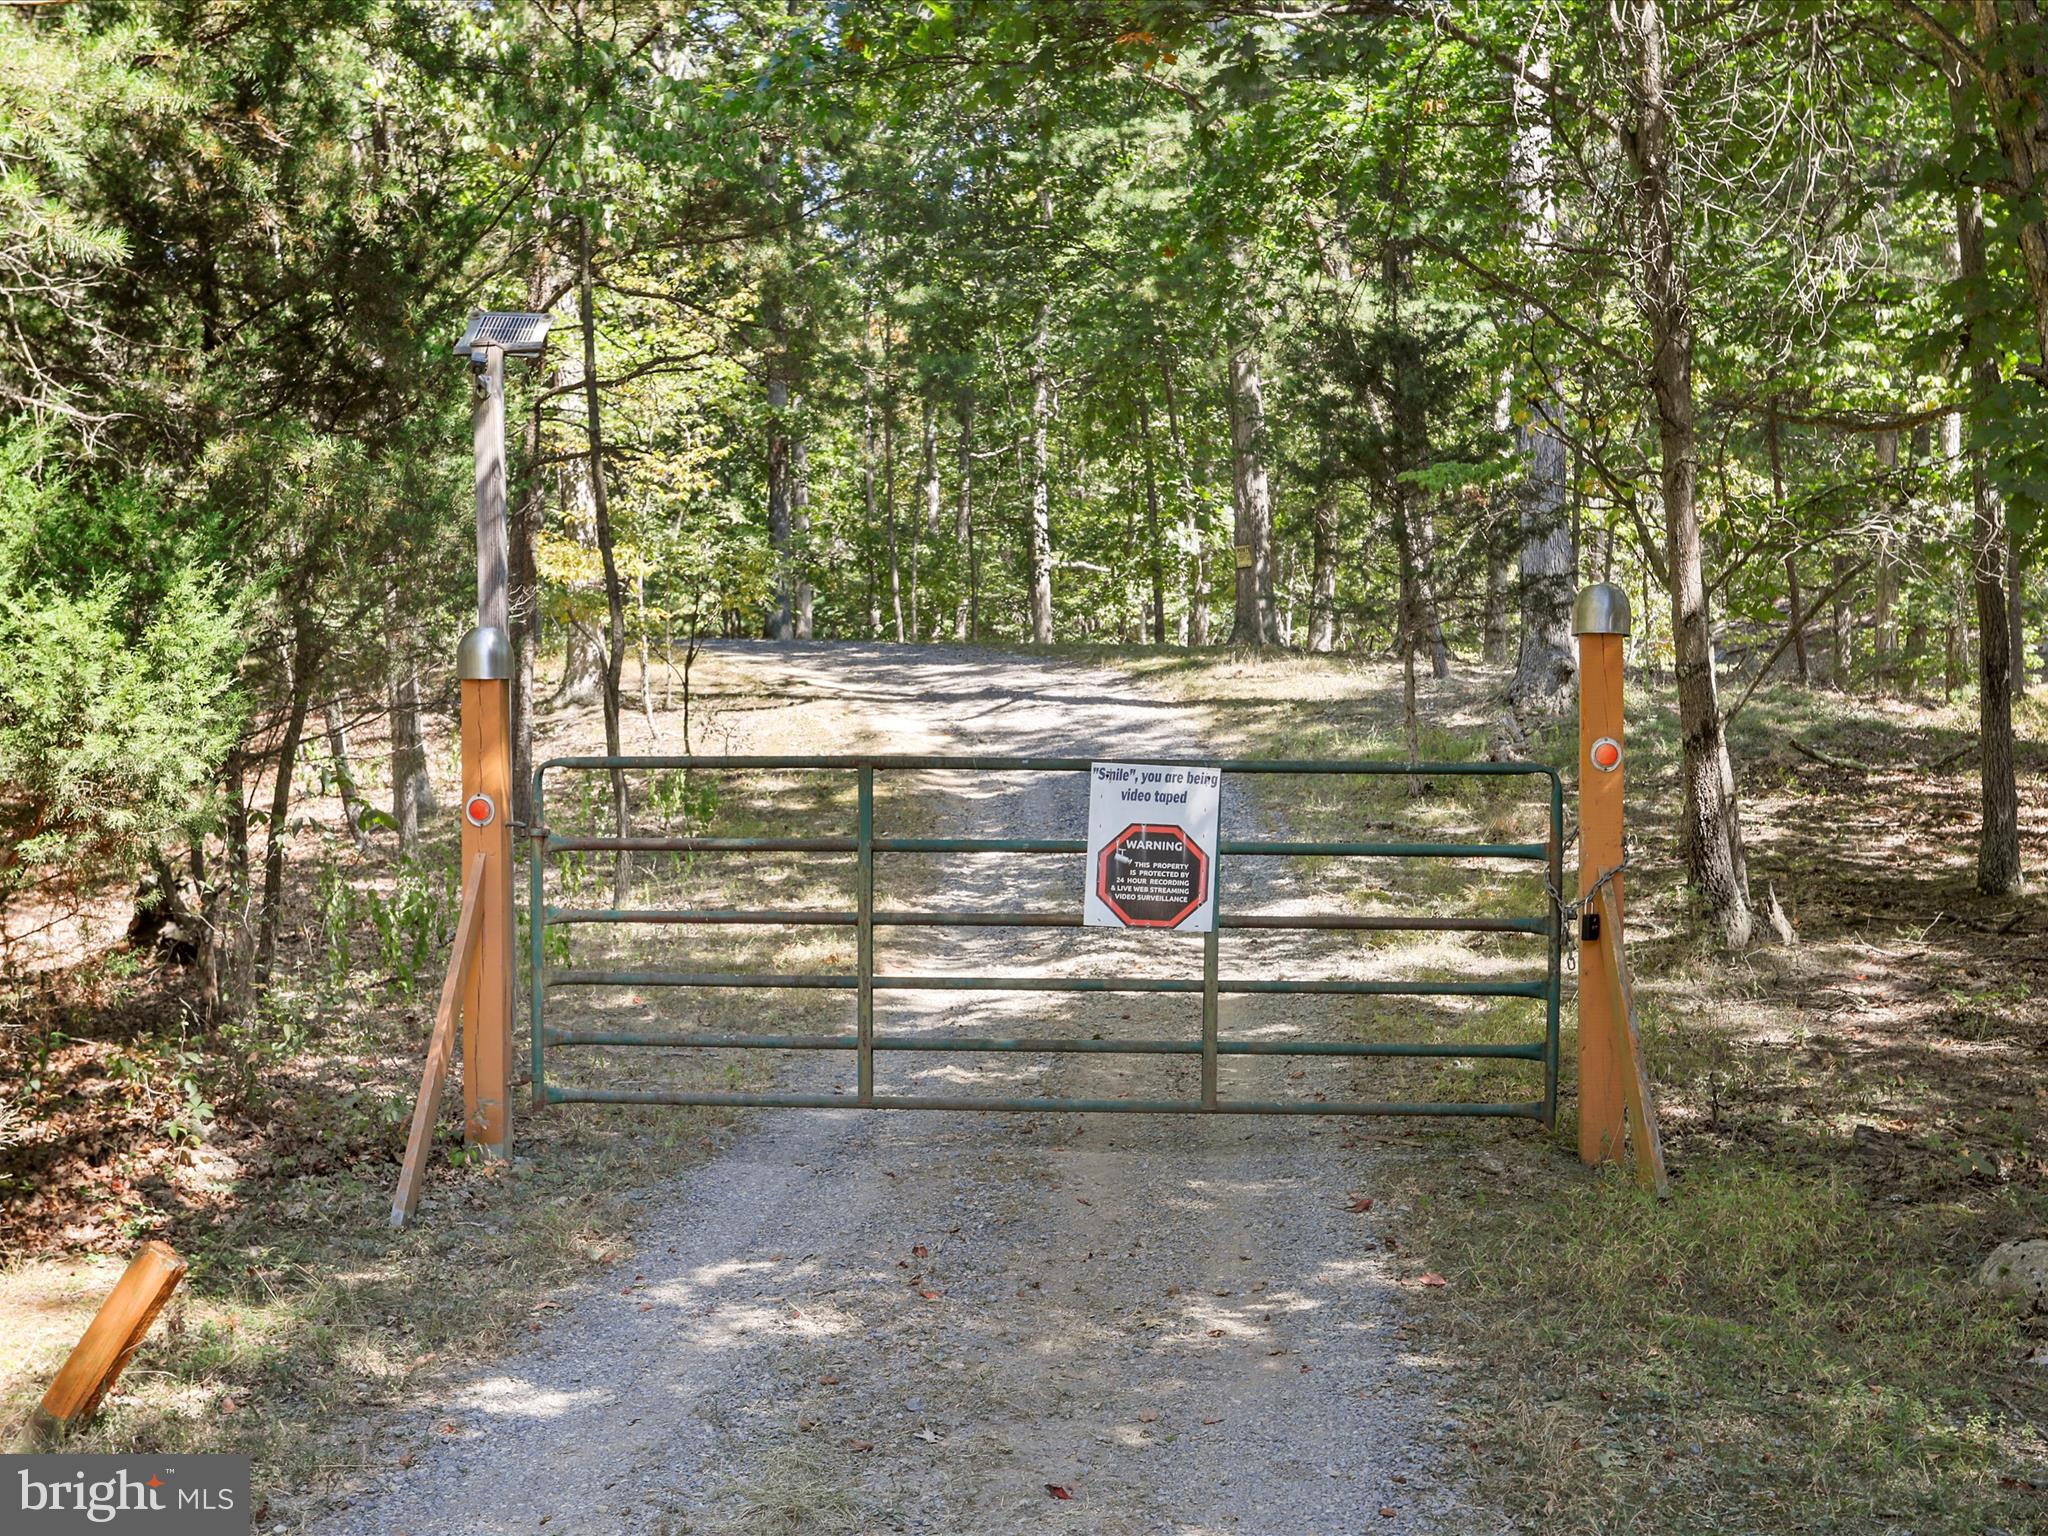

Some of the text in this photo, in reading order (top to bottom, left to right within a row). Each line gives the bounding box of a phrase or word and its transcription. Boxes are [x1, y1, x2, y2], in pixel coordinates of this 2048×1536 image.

[1141, 772, 1161, 785] you
[1165, 772, 1183, 783] are
[1186, 771, 1218, 788] being
[1121, 788, 1188, 805] video taped
[1126, 840, 1183, 851] WARNING
[1153, 862, 1189, 870] PROPERTY
[1150, 879, 1190, 887] RECORDING
[1150, 887, 1190, 895] STREAMING
[1137, 894, 1188, 903] SURVEILLANCE
